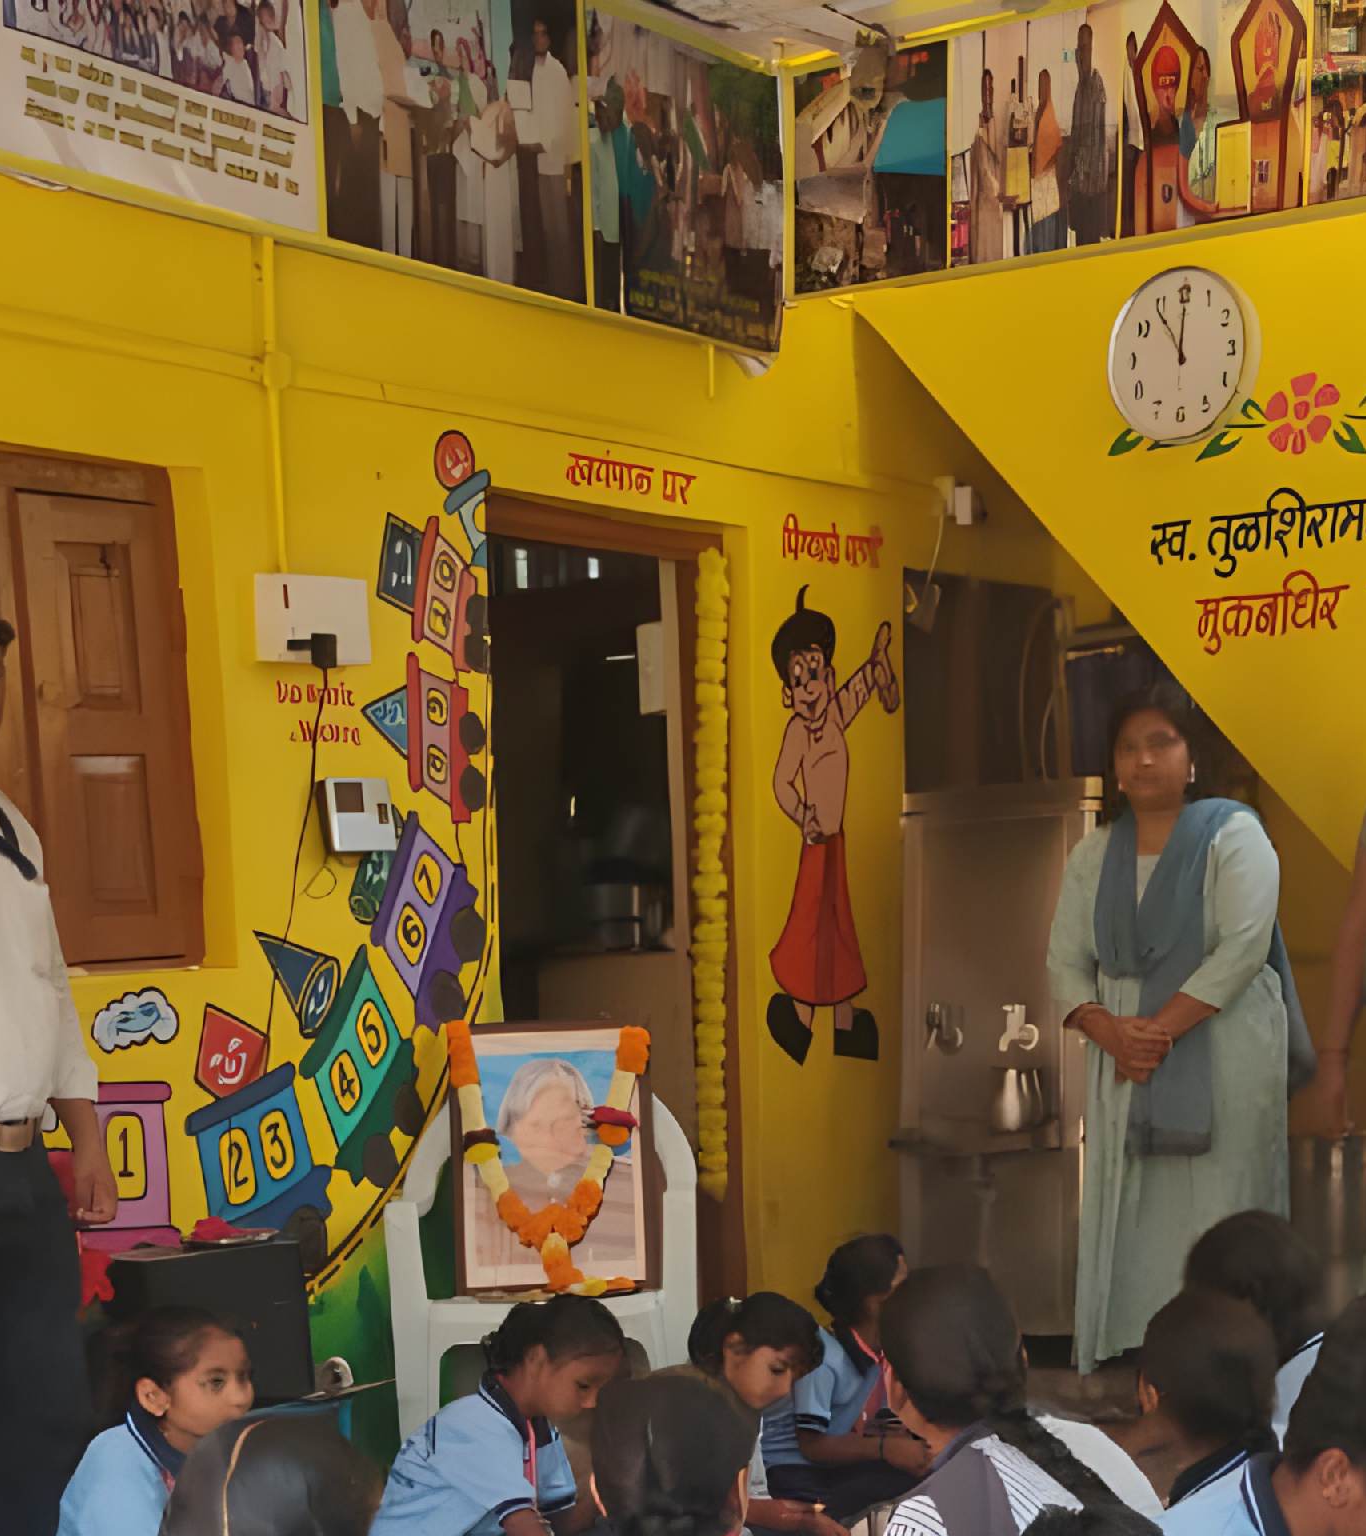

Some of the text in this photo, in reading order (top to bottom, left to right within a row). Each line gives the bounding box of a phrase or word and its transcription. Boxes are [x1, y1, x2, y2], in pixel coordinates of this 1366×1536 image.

[1150, 519, 1197, 565] स्व.
[401, 913, 423, 950] 6
[364, 1008, 382, 1053] 5
[338, 1058, 356, 1098] 4
[118, 1127, 135, 1178] 1
[227, 1122, 288, 1188] 2 3
